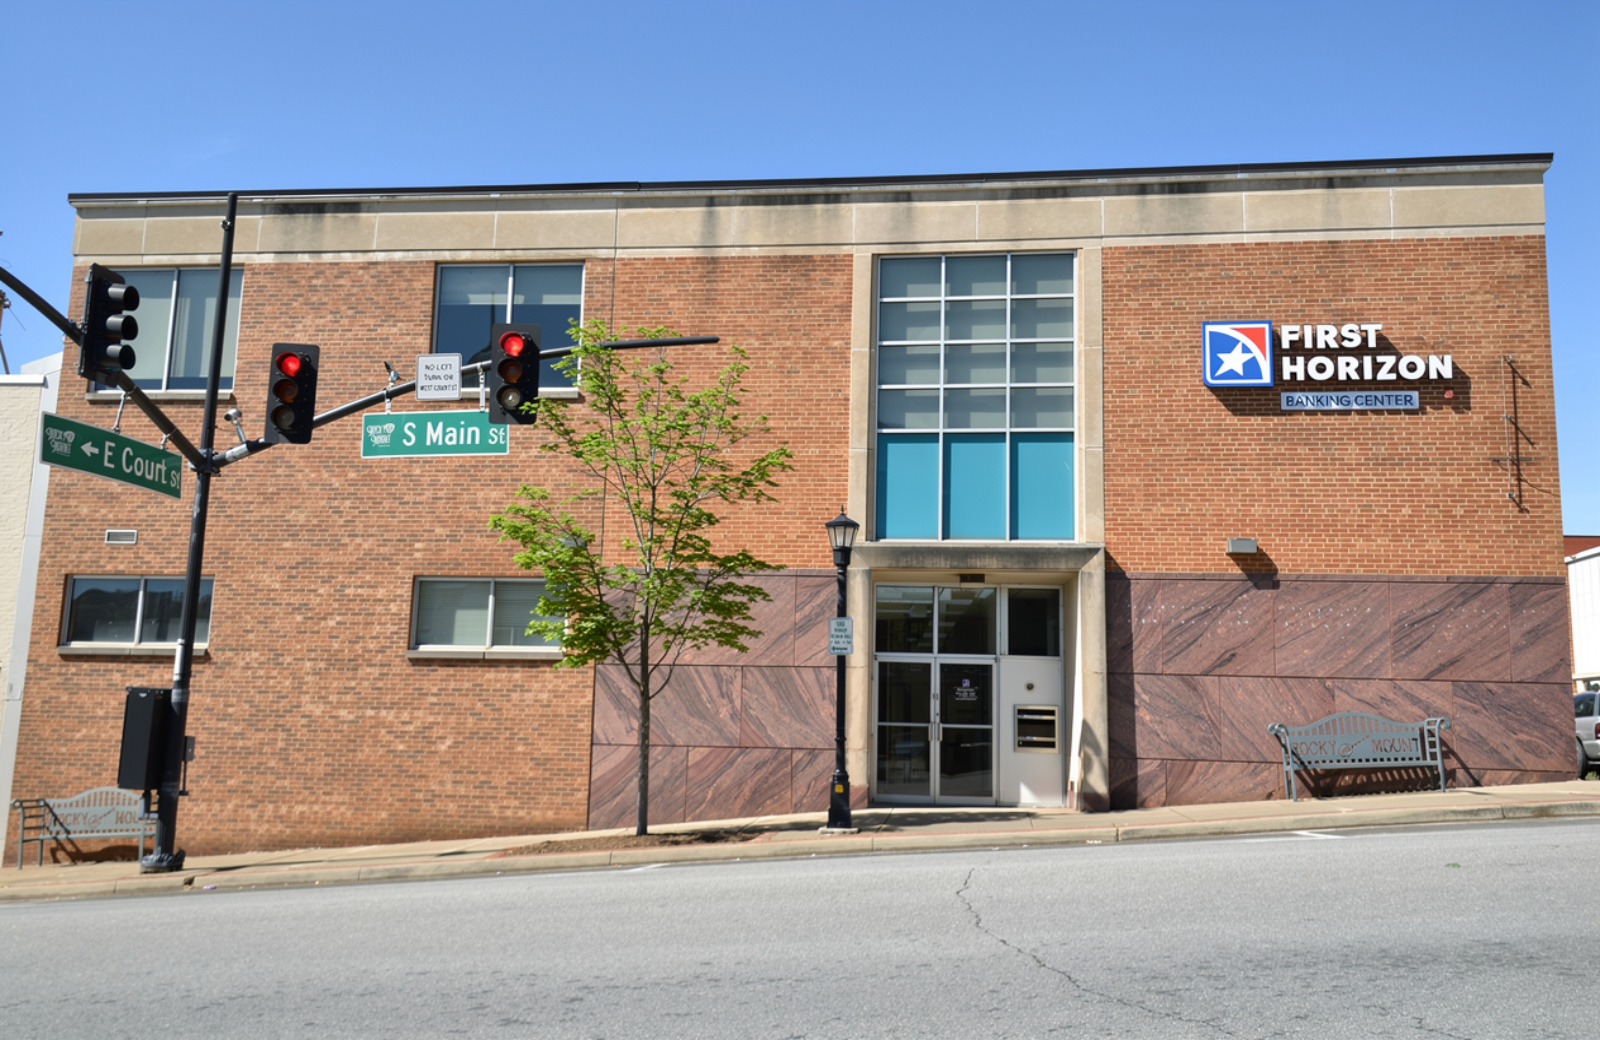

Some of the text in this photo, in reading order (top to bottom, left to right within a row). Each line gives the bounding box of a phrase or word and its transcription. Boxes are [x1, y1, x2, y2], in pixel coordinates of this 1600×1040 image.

[1280, 323, 1383, 349] FIRST
[1281, 354, 1453, 381] HORIZON
[1285, 394, 1414, 408] BANKING CENTER
[402, 422, 416, 447] S
[425, 421, 480, 446] Main
[488, 427, 506, 445] St
[103, 440, 117, 469] E
[122, 447, 168, 484] Court
[1371, 738, 1420, 754] MOUNT
